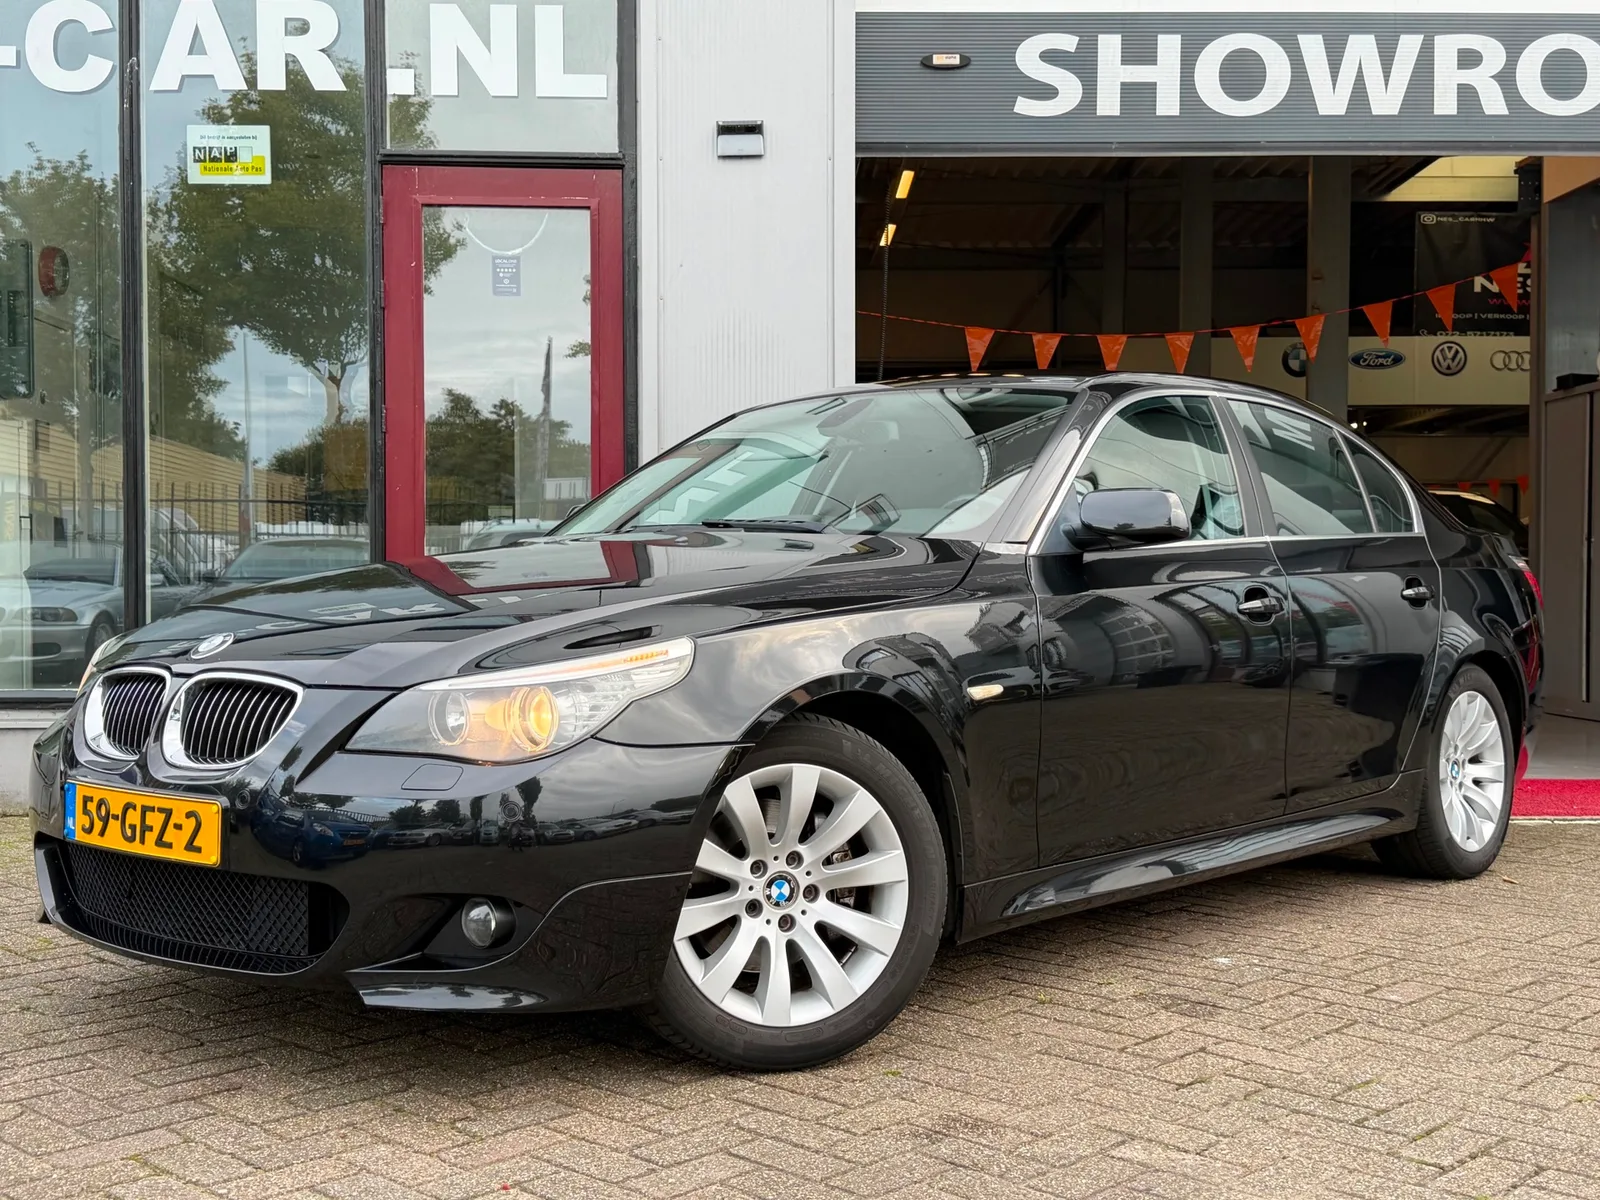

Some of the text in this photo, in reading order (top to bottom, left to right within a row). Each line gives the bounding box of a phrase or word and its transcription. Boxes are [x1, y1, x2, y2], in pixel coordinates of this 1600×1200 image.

[1013, 32, 1600, 117] SHOWRO
[195, 147, 236, 160] NAP
[1359, 351, 1395, 367] Ford
[81, 795, 202, 854] 59-GFZ-2
